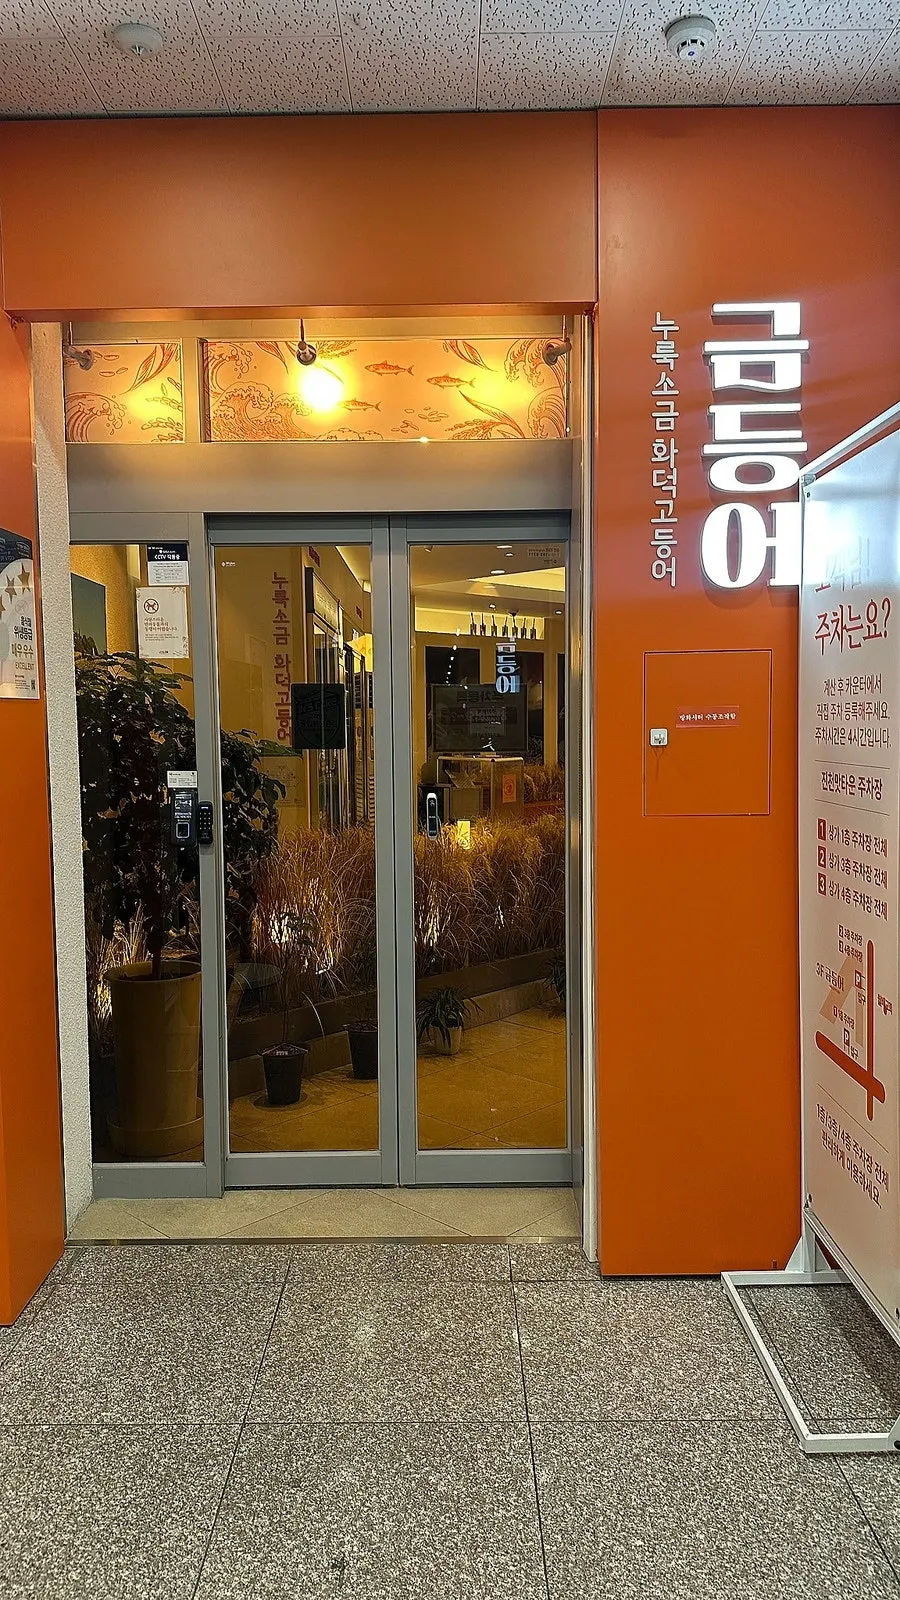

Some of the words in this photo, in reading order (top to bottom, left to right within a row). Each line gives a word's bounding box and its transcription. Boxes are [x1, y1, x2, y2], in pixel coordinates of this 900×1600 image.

[651, 311, 680, 431] 누룩소금
[701, 301, 809, 588] 금등어
[650, 437, 679, 587] 화덕고등어
[271, 572, 291, 645] 누룩소금
[815, 597, 892, 655] 주차는요?
[823, 678, 837, 696] 계산
[837, 677, 844, 695] 후
[845, 674, 882, 695] 카운터에서
[816, 703, 829, 721] 직접
[830, 703, 843, 720] 주차
[844, 701, 890, 721] 등록해주세요.
[815, 727, 846, 746] 주차시간은
[847, 727, 892, 748] 4시간입니다.
[821, 771, 856, 796] 진천맛타운
[858, 776, 883, 801] 주차장
[828, 824, 840, 843] 상가
[841, 828, 851, 846] 1층
[851, 830, 872, 853] 주차장
[873, 836, 888, 858] 전체
[828, 852, 840, 872] 상가
[840, 857, 851, 876] 3층
[852, 860, 873, 883] 주차장
[873, 867, 888, 890] 전체
[828, 880, 840, 900] 상가
[840, 886, 851, 905] 4층
[852, 890, 873, 914] 주차장
[873, 898, 888, 921] 전체
[816, 962, 824, 978] 3F
[825, 966, 844, 992] 금등어
[846, 1157, 882, 1209] 이용하세요.
[852, 1139, 873, 1174] 주차장
[874, 1161, 890, 1193] 전체
